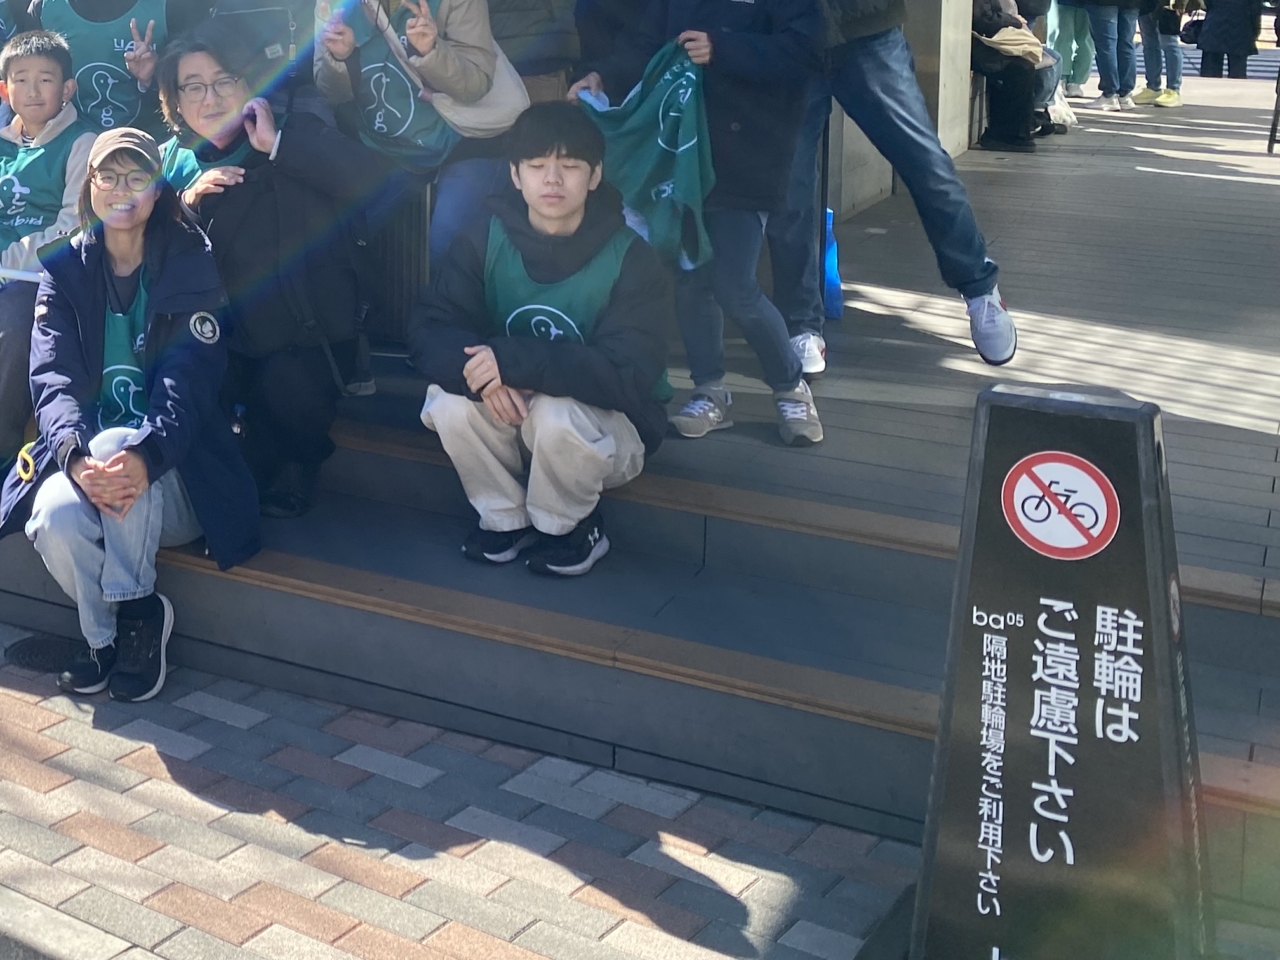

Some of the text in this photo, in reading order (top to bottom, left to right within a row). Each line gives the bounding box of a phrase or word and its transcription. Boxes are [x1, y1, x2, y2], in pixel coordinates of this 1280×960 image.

[976, 632, 1008, 917] 隔地駐輪場をご利用下さい
[1029, 596, 1080, 866] ご遠慮下さい
[1093, 604, 1144, 744] 駐輪は
